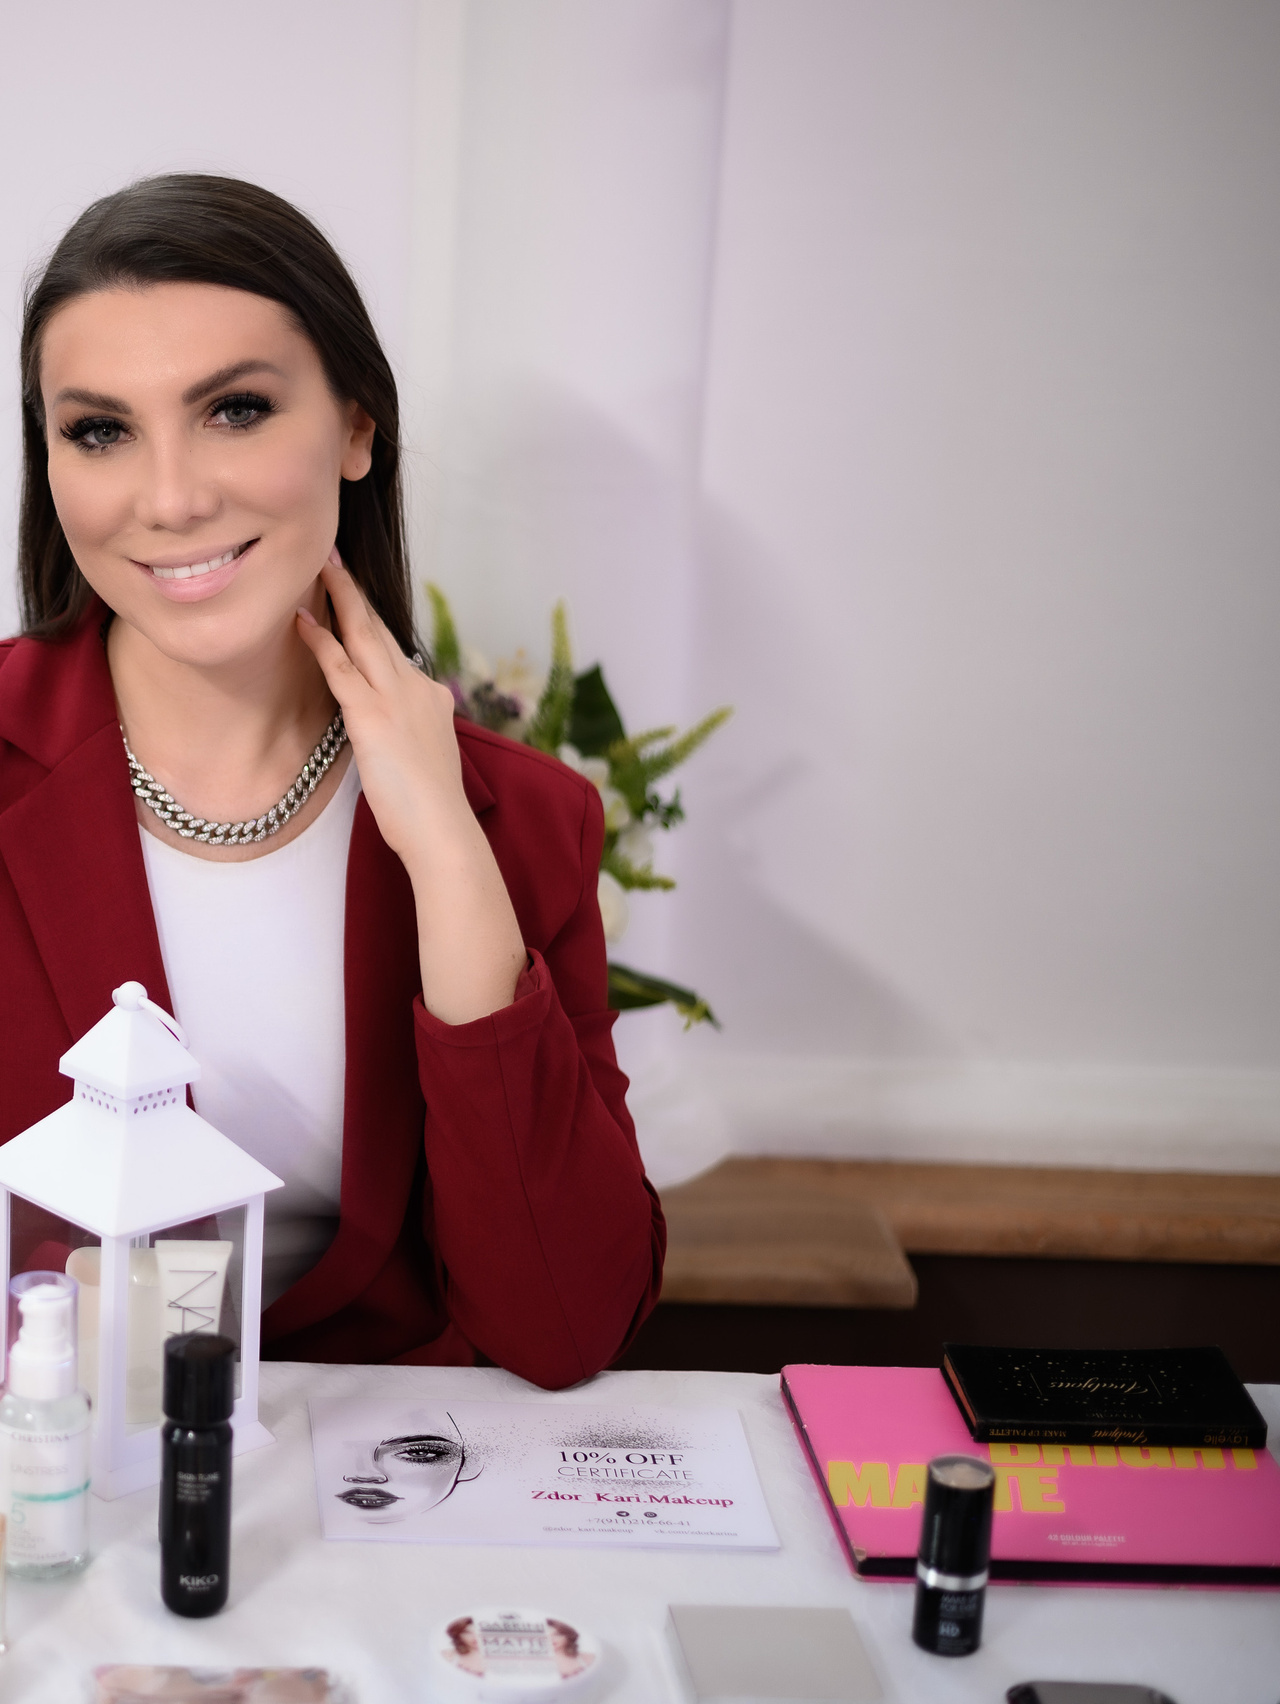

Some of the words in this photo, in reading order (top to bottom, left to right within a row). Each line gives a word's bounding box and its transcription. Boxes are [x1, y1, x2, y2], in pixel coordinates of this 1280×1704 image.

[11, 1432, 70, 1443] CHRISTINA
[989, 1428, 1027, 1437] PALETTE
[1028, 1429, 1040, 1437] UP
[1042, 1429, 1067, 1437] MAKE
[1204, 1434, 1249, 1447] Lavelle
[558, 1451, 617, 1465] 10%
[625, 1453, 685, 1466] OFF
[557, 1466, 695, 1480] CERTIFICATE
[827, 1461, 1066, 1513] MATE
[531, 1490, 734, 1508] Zdor_Kari.Makeup
[11, 1502, 26, 1524] 5
[179, 1573, 219, 1586] KIKO
[939, 1622, 960, 1637] HD
[483, 1636, 548, 1646] MATTE
